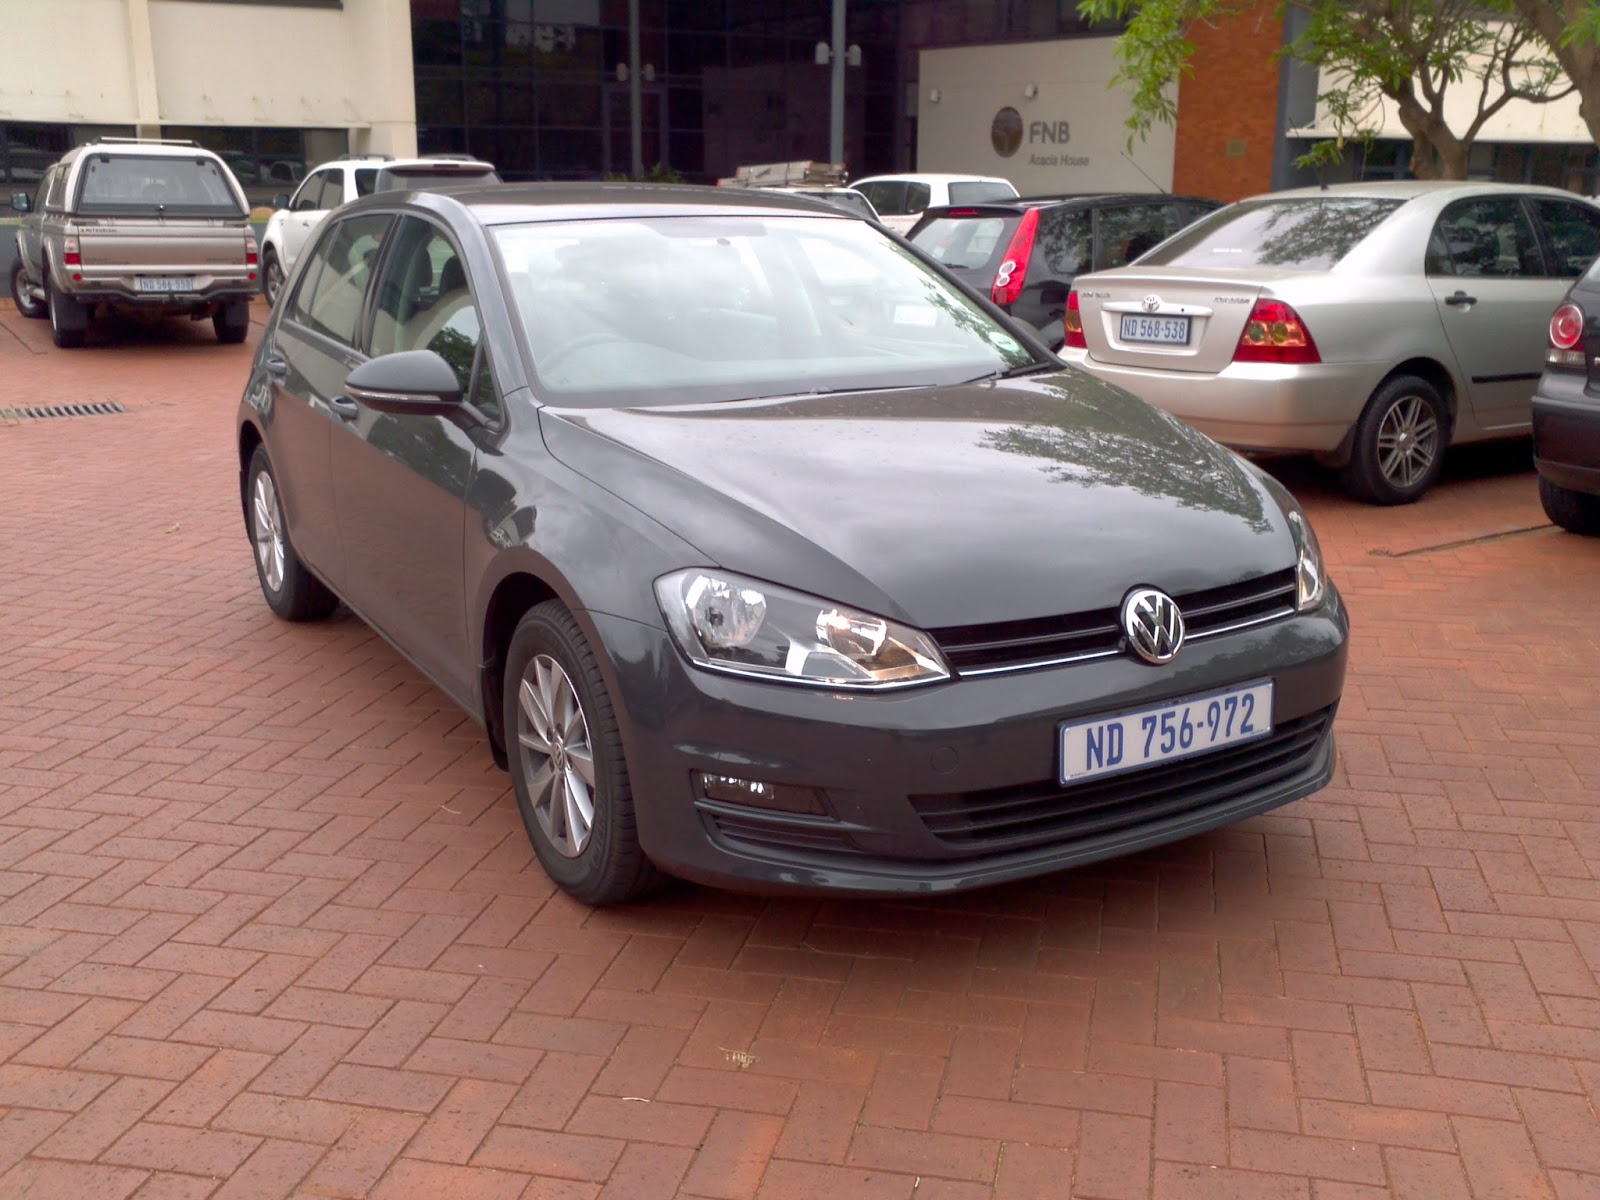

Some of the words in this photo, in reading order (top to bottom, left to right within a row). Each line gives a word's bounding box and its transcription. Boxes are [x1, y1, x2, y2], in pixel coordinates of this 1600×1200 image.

[1029, 121, 1071, 144] FNB
[1029, 154, 1058, 166] Acacia
[1060, 155, 1090, 167] House
[1124, 319, 1138, 336] ND
[1140, 320, 1186, 339] 568-538
[1086, 722, 1124, 771] ND
[1141, 693, 1255, 758] 756-972
